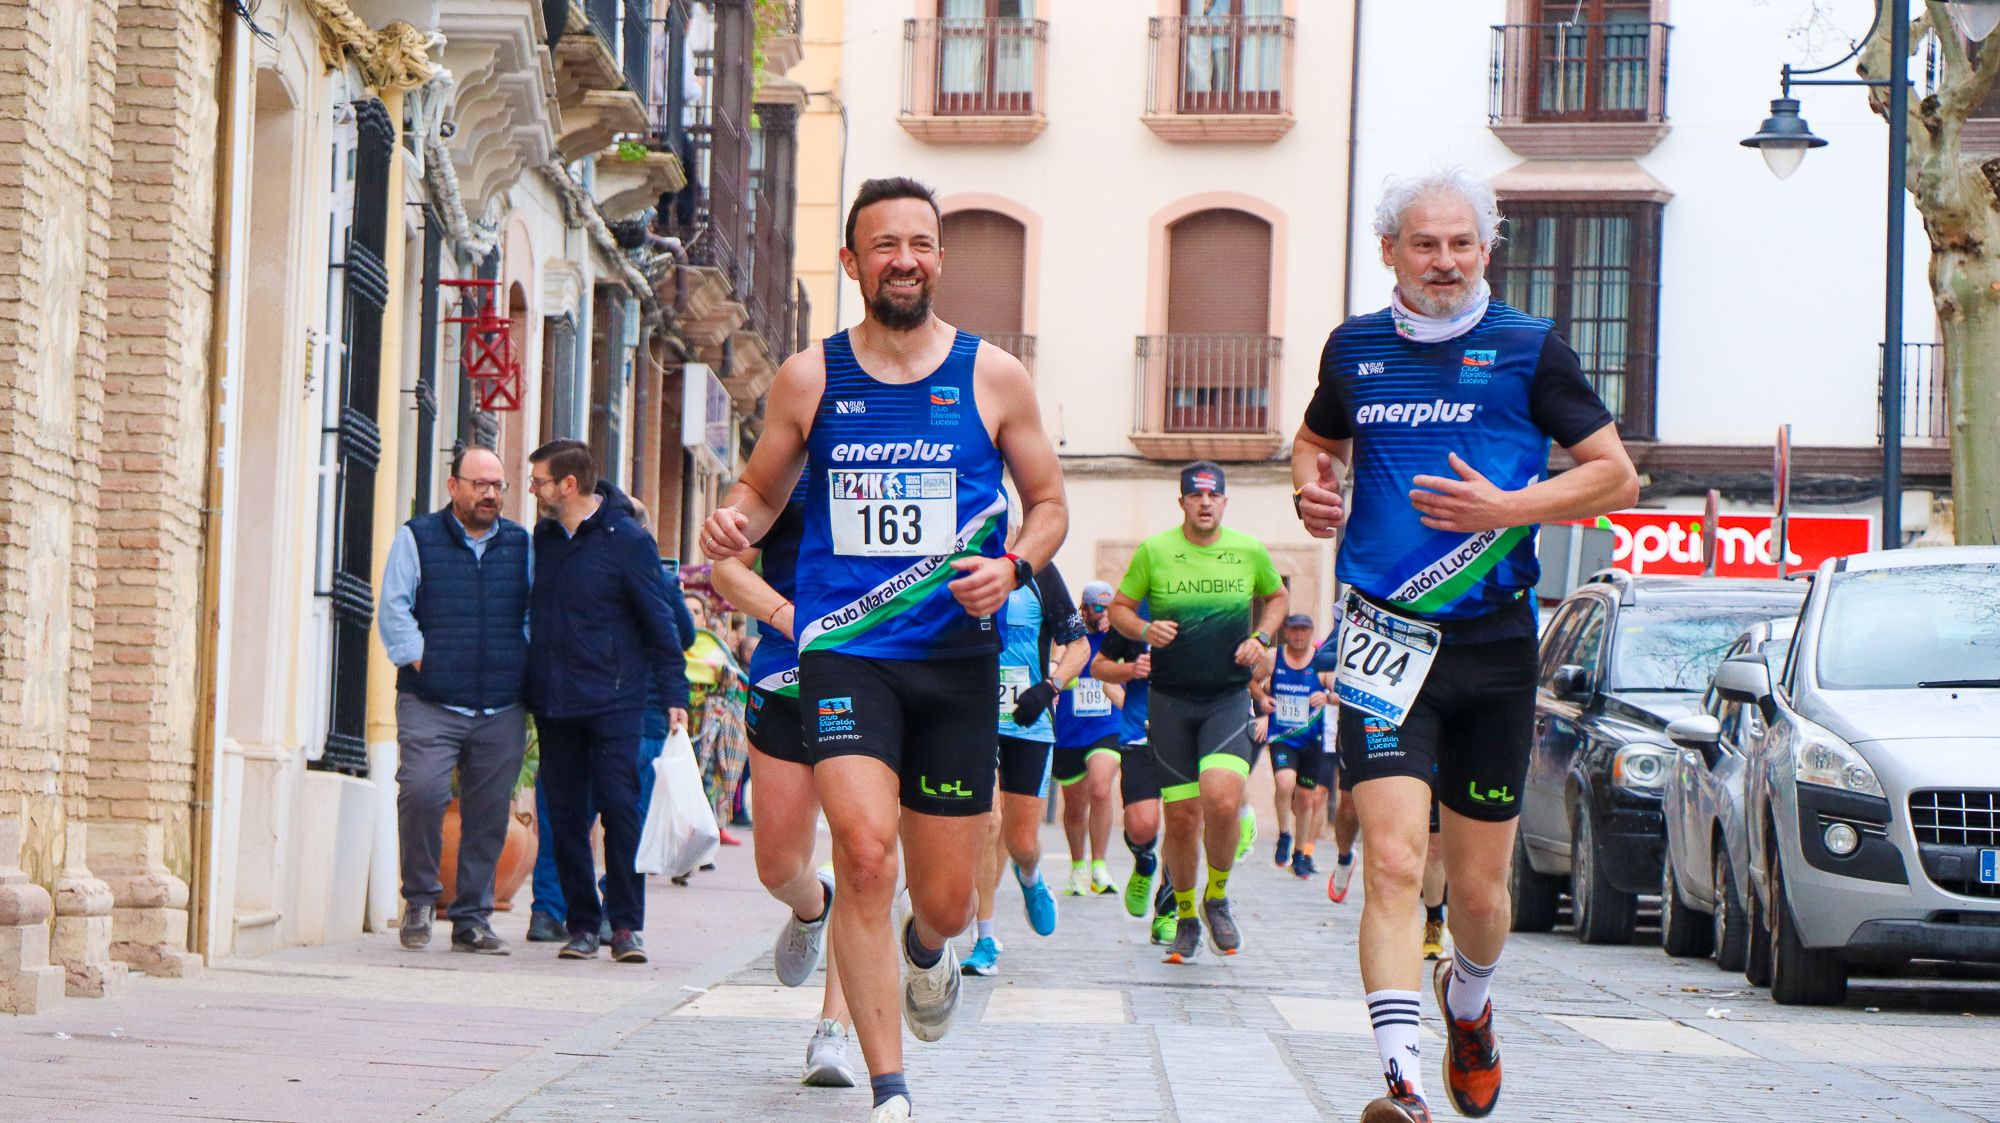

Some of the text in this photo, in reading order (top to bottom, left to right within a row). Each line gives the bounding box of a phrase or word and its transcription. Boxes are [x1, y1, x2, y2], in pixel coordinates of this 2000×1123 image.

[1357, 399, 1476, 427] enerplus
[831, 439, 955, 465] enerplus
[857, 504, 922, 546] 163
[1439, 528, 1497, 576] Lucena
[1167, 578, 1245, 595] LANDBIKE
[821, 608, 859, 631] Club
[858, 575, 918, 615] Maratón
[819, 725, 853, 733] Lucena
